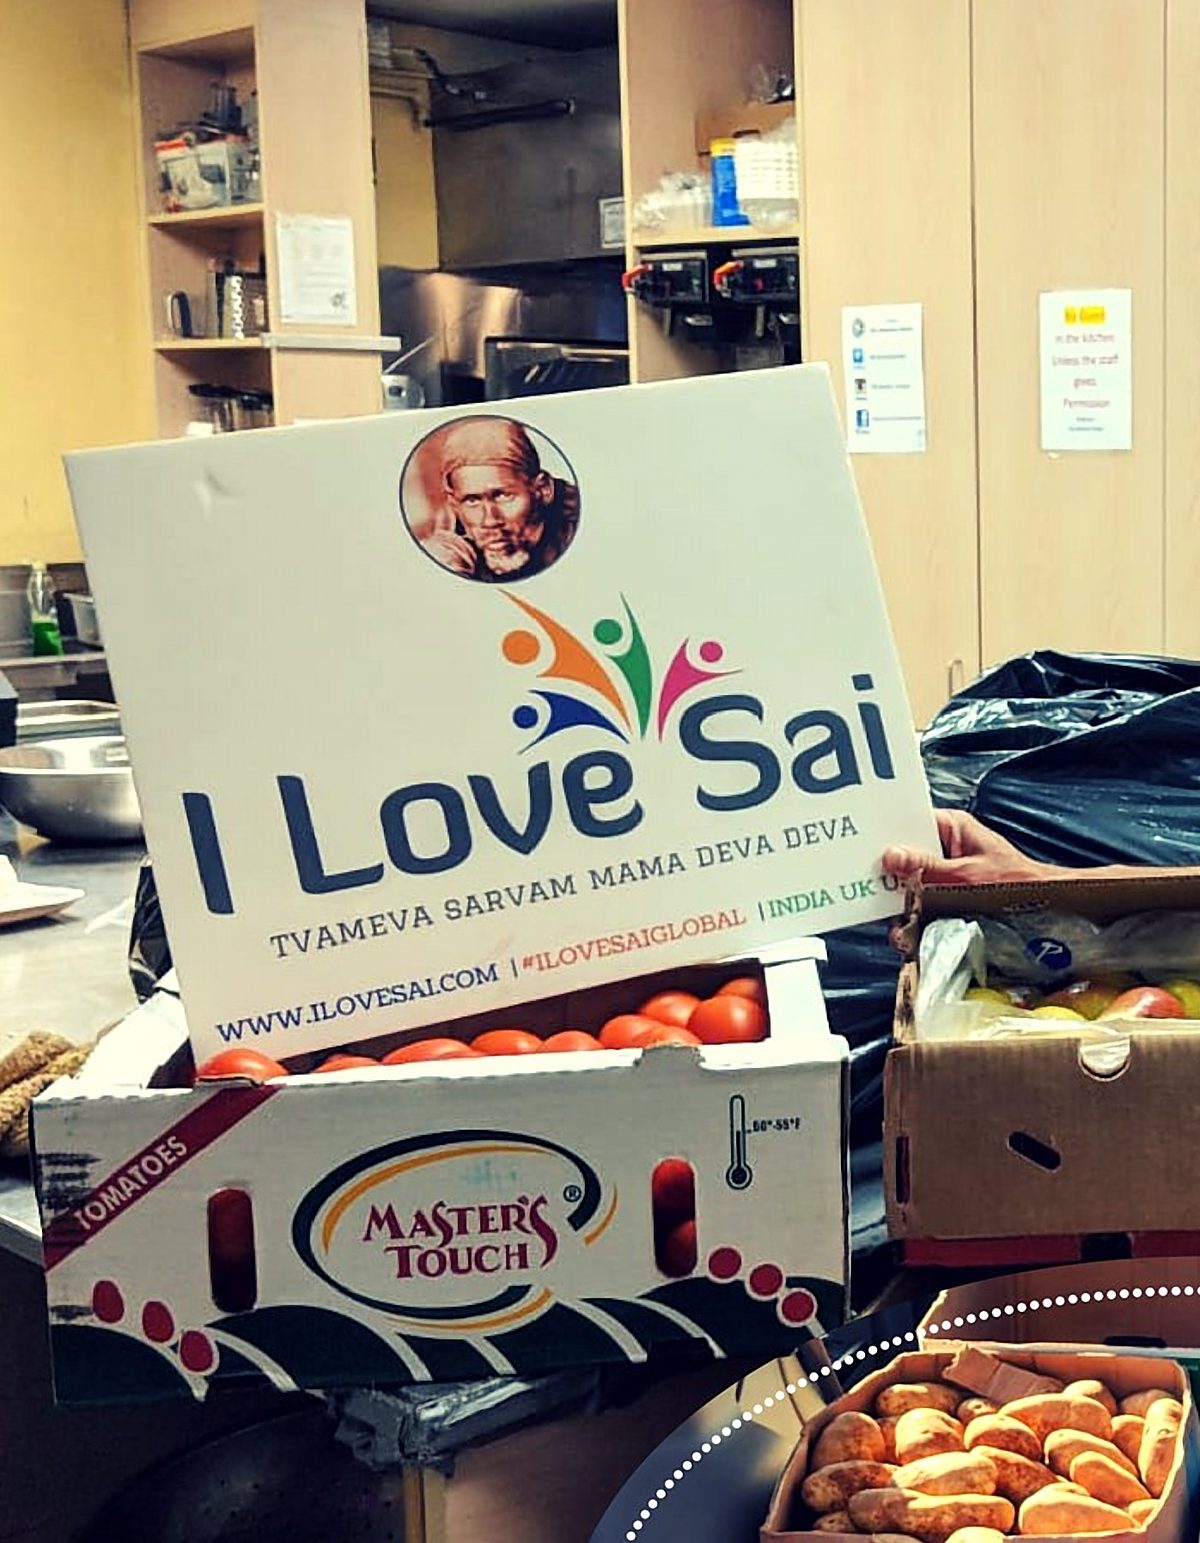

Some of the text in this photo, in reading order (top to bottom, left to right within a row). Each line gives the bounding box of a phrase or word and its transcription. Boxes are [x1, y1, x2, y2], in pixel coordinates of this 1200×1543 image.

[182, 673, 896, 914] I Love Sai
[270, 815, 859, 958] TVAMEVA SARVAM MAMA DEVA DEVA
[839, 878, 876, 901] UK
[74, 1135, 188, 1230] TOMATOES
[362, 1195, 558, 1268] MASTER'S
[384, 1243, 530, 1280] TOUCH
